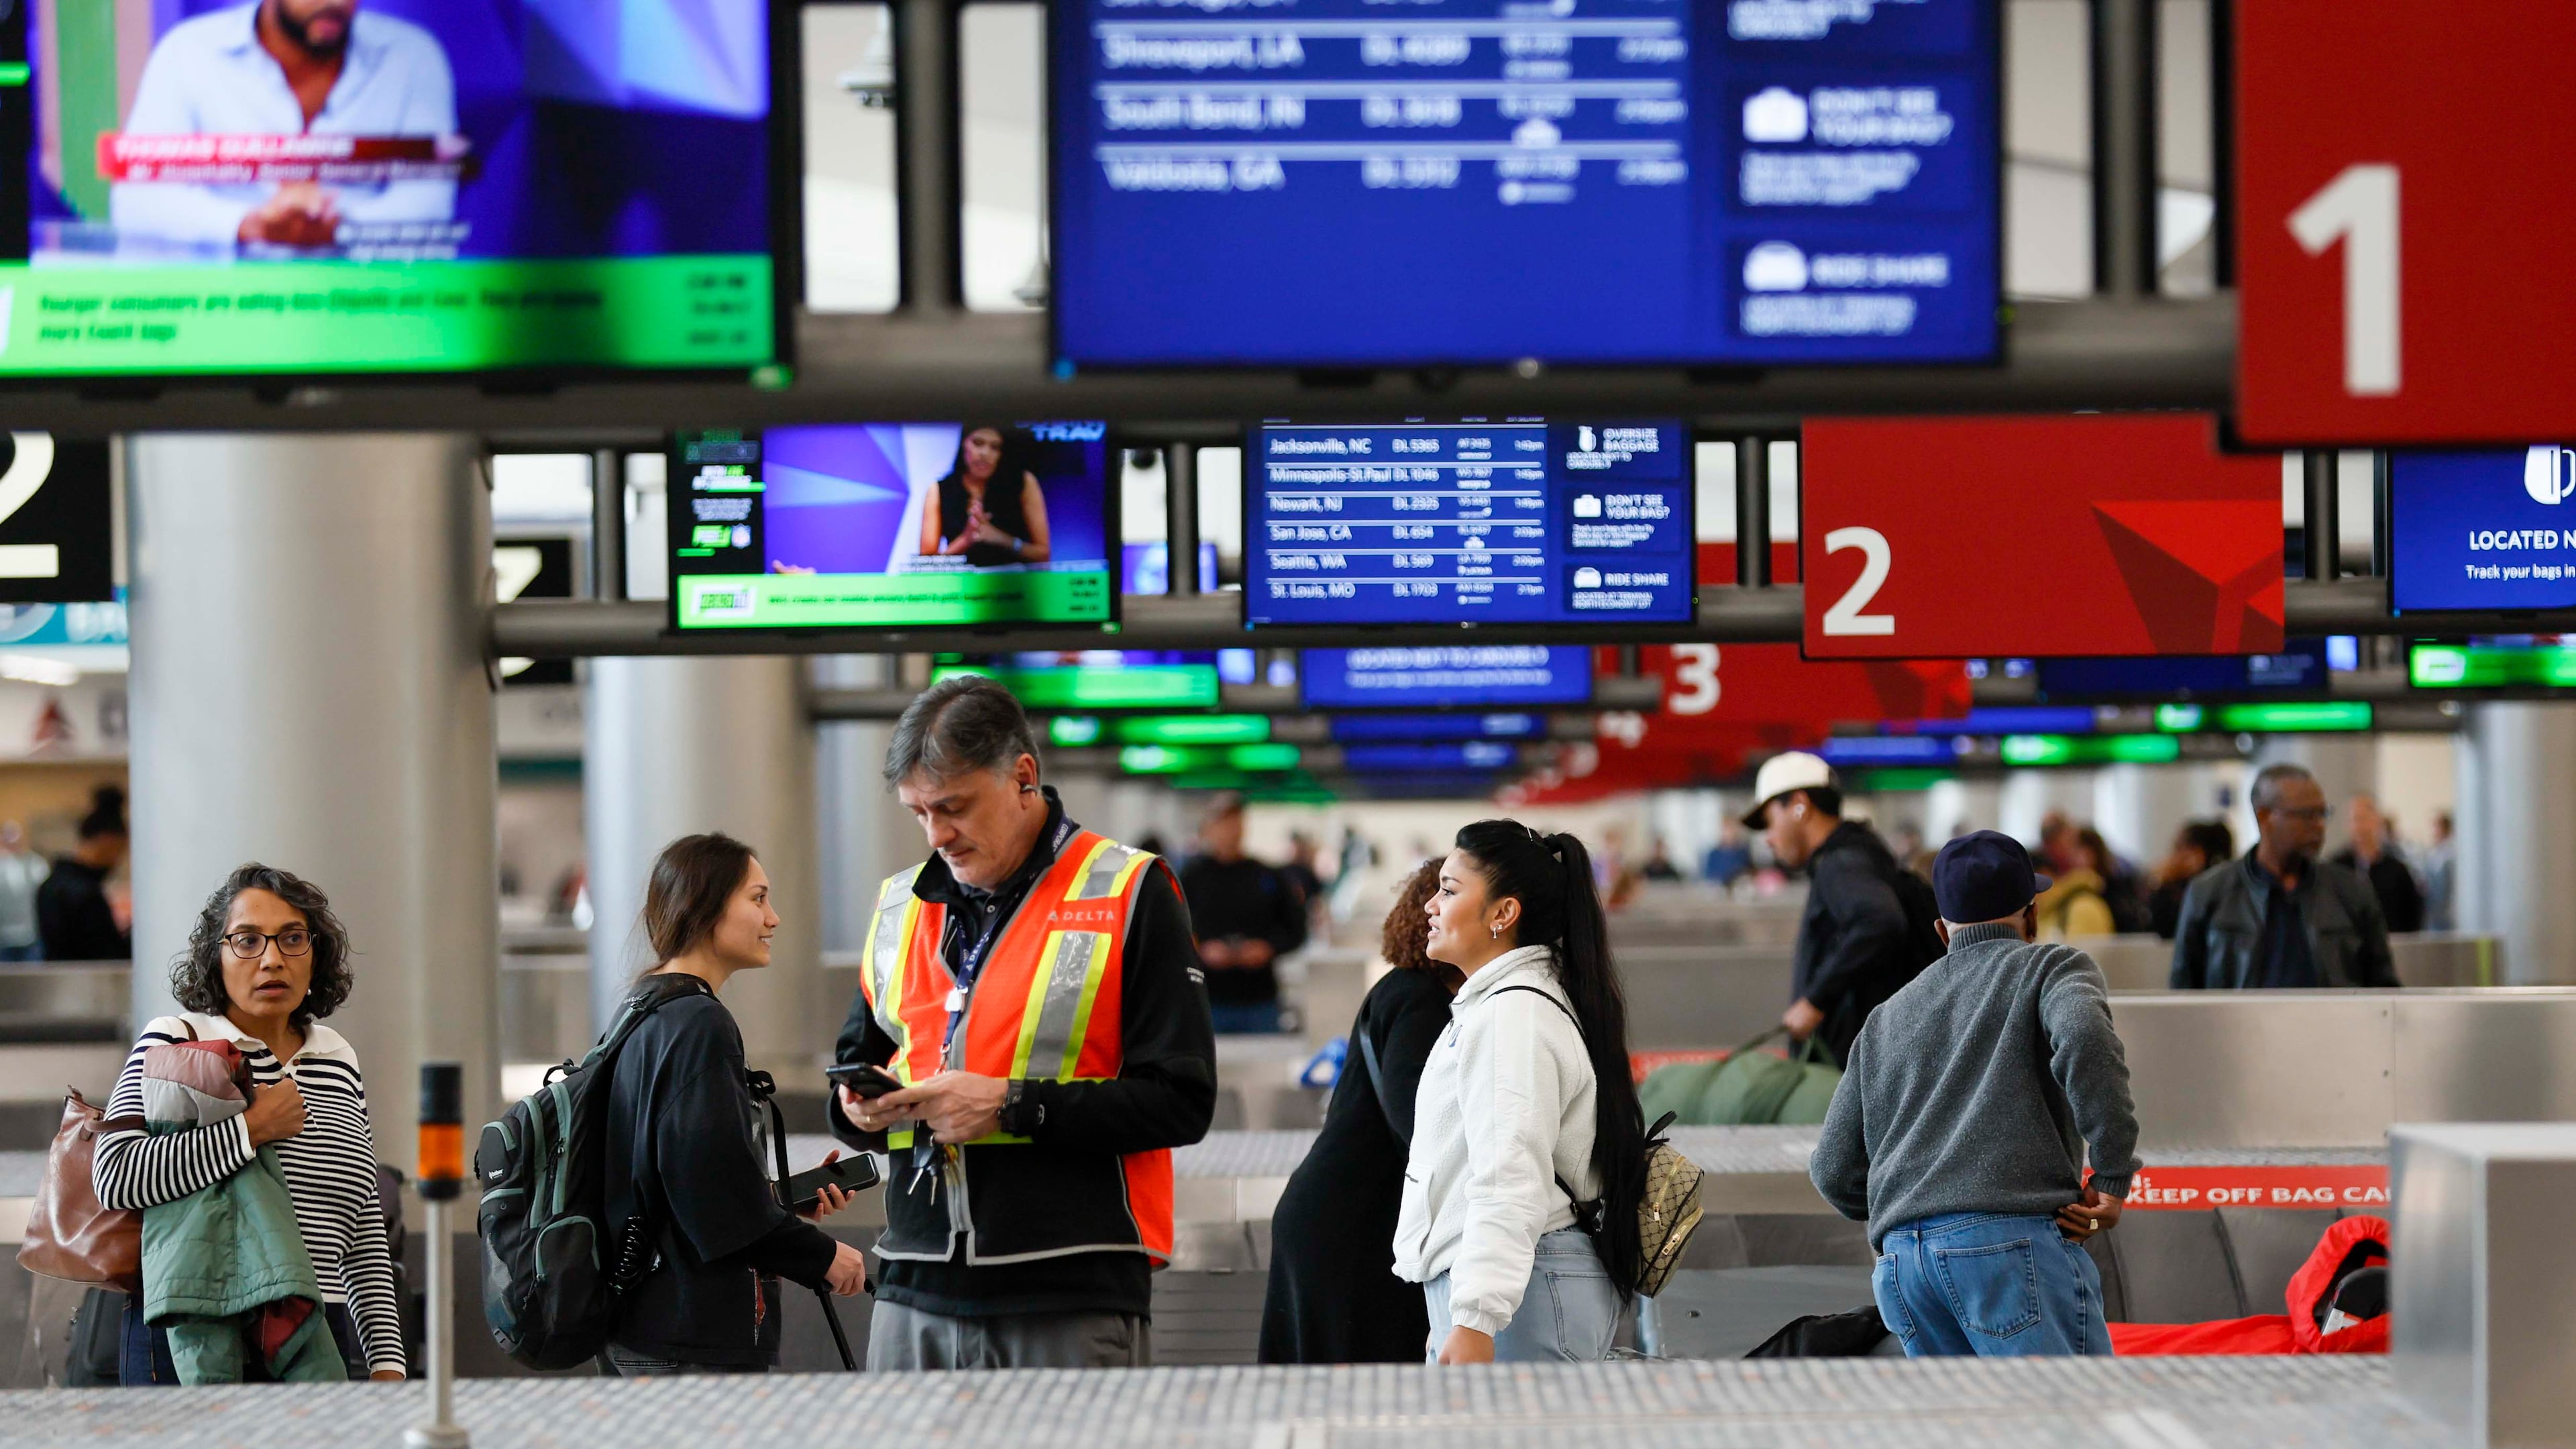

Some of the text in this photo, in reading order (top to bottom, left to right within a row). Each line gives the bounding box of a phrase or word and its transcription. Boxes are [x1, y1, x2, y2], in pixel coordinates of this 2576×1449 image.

[2286, 163, 2402, 396] 1
[1270, 437, 1372, 455] Jacksonville, NC
[1392, 439, 1440, 453] DL 5365
[1392, 468, 1409, 482] DL
[1270, 497, 1342, 513] Newark, NJ
[1392, 497, 1440, 511] DL 2325
[1643, 494, 1664, 506] SEE
[1605, 506, 1639, 519] YOUR
[1270, 525, 1352, 541] San Jose, CA
[1392, 526, 1434, 539] DL 654
[2469, 530, 2559, 550] LOCATED
[1270, 554, 1347, 570] Seattle, WA
[1392, 554, 1434, 568] DL 569
[1605, 573, 1669, 586] RIDE SHARE
[2465, 564, 2500, 580] Track
[2502, 567, 2530, 581] your
[2532, 564, 2561, 581] bags
[1823, 527, 1895, 635] 2
[1270, 583, 1355, 598] St. Louis, MO
[1393, 583, 1438, 597] DL 1703
[1668, 643, 1721, 715] 3
[1064, 910, 1114, 921] DELTA
[2125, 1188, 2199, 1204] KEEP
[2206, 1187, 2263, 1203] OFF
[2271, 1187, 2335, 1203] BAG
